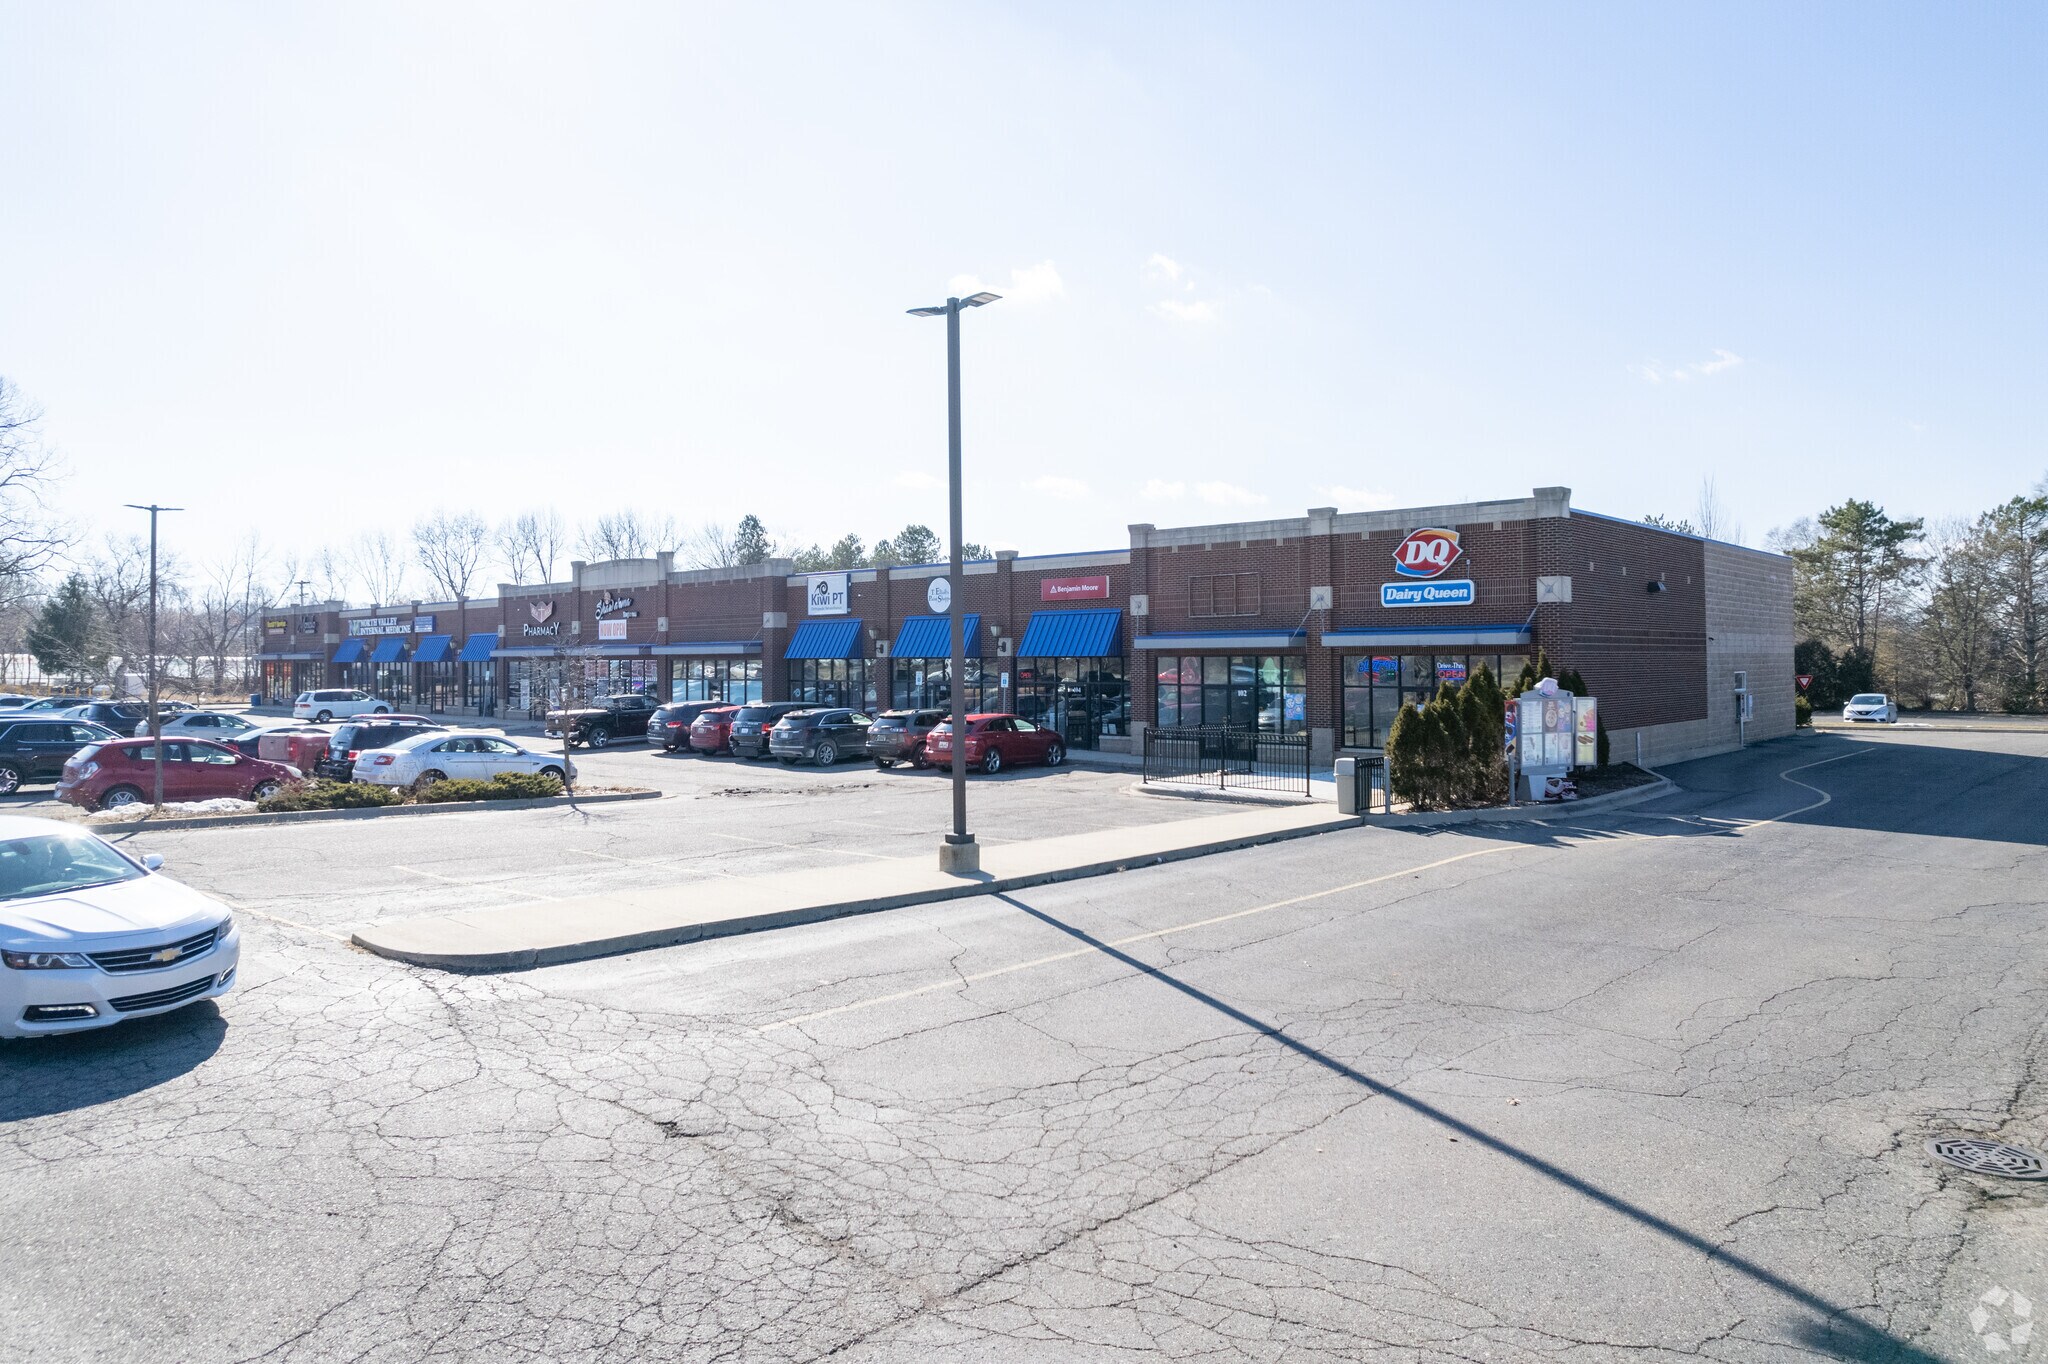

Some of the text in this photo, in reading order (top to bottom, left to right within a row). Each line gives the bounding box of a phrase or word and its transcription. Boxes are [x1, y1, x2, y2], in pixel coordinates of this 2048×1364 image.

[1404, 538, 1449, 566] DQ
[1057, 585, 1081, 593] Benjamin
[1386, 587, 1468, 602] Dairy Queen
[811, 592, 844, 606] Kiwi PT
[360, 617, 398, 627] NORTH VALLEY
[360, 626, 385, 636] INTERNAL
[385, 624, 411, 635] MEDICINE
[600, 622, 626, 637] NOW OPEN
[1436, 662, 1466, 670] Drive-Thru
[1438, 670, 1466, 678] OPEN
